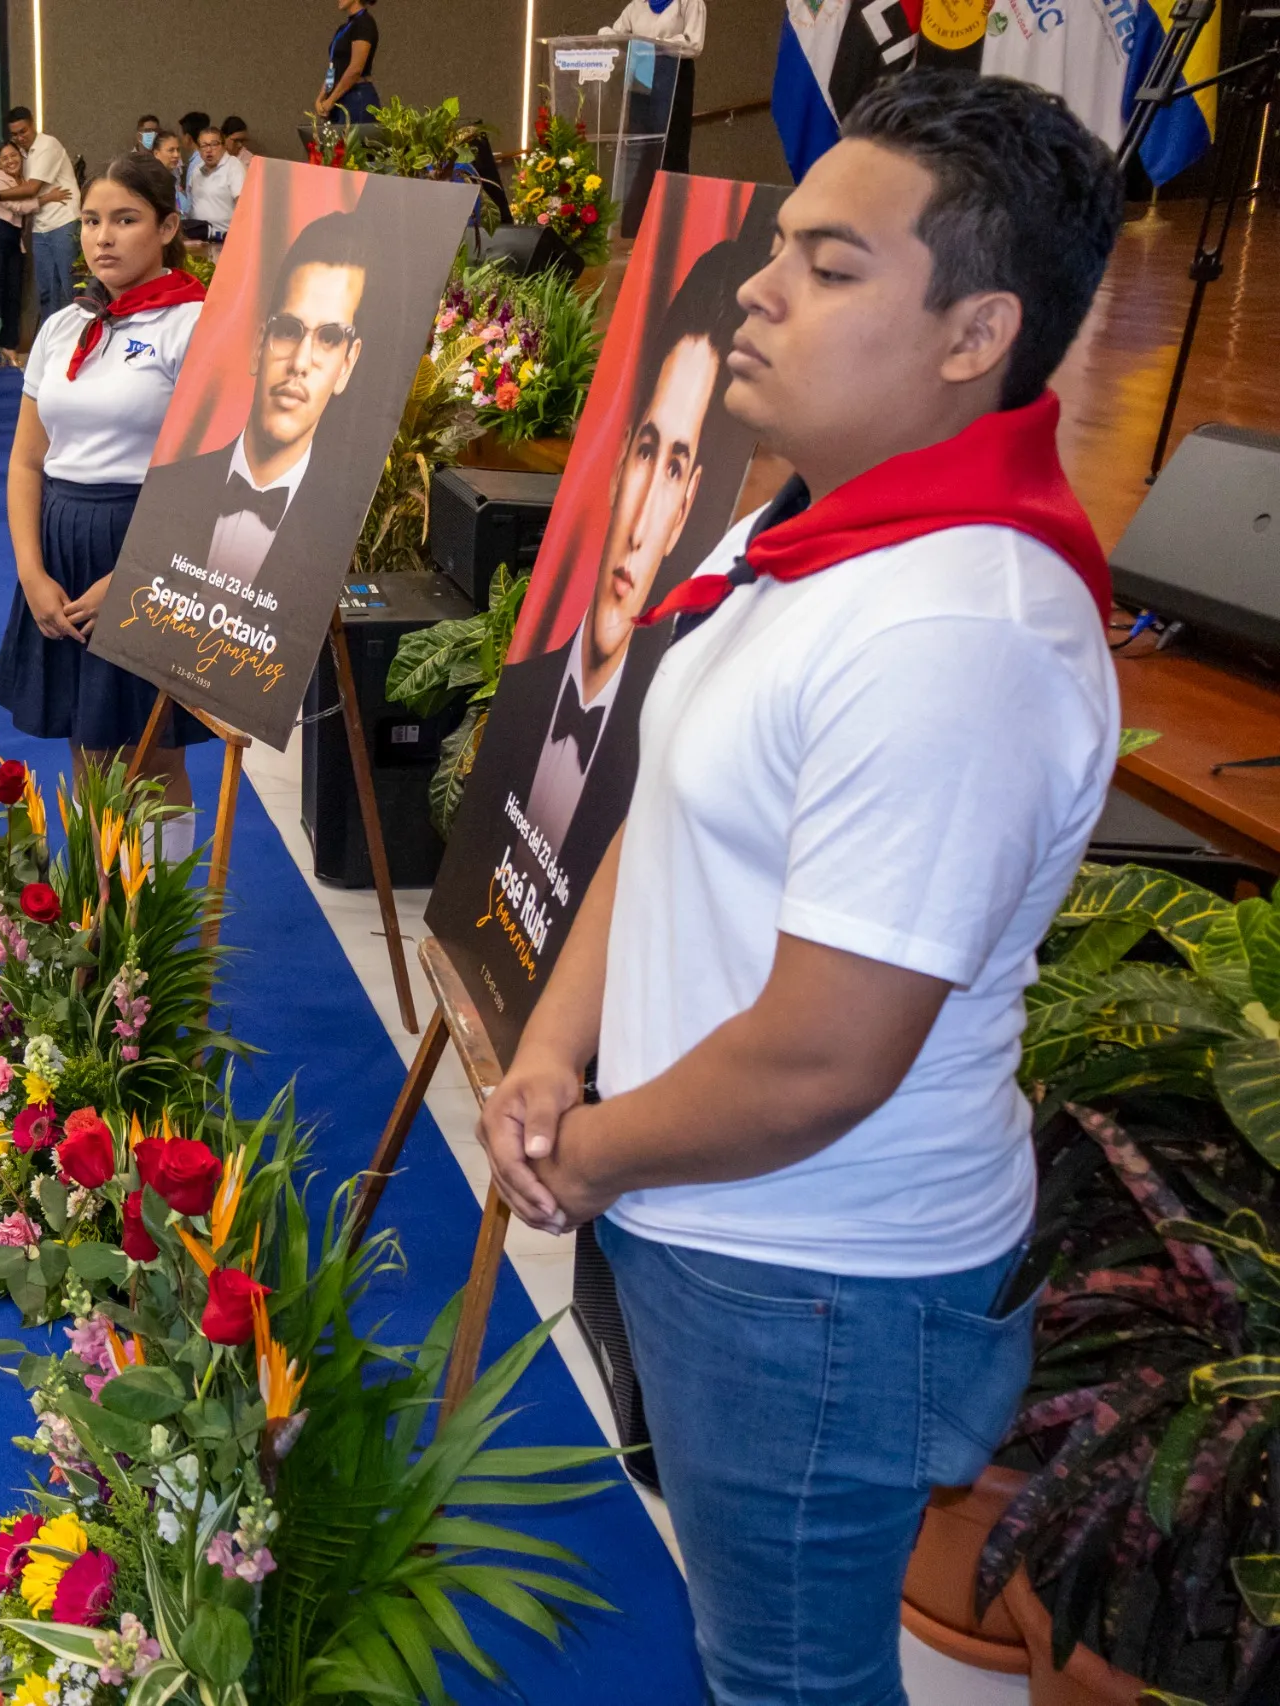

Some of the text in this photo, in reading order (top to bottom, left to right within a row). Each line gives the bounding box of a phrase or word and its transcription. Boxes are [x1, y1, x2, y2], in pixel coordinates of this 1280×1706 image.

[147, 576, 277, 654] Sergio Octavio
[170, 553, 278, 611] Héroes del 23 de julio
[176, 668, 211, 689] 23-07-1959
[504, 791, 569, 906] Héroes del 23 de julio
[495, 845, 553, 955] José Rubí
